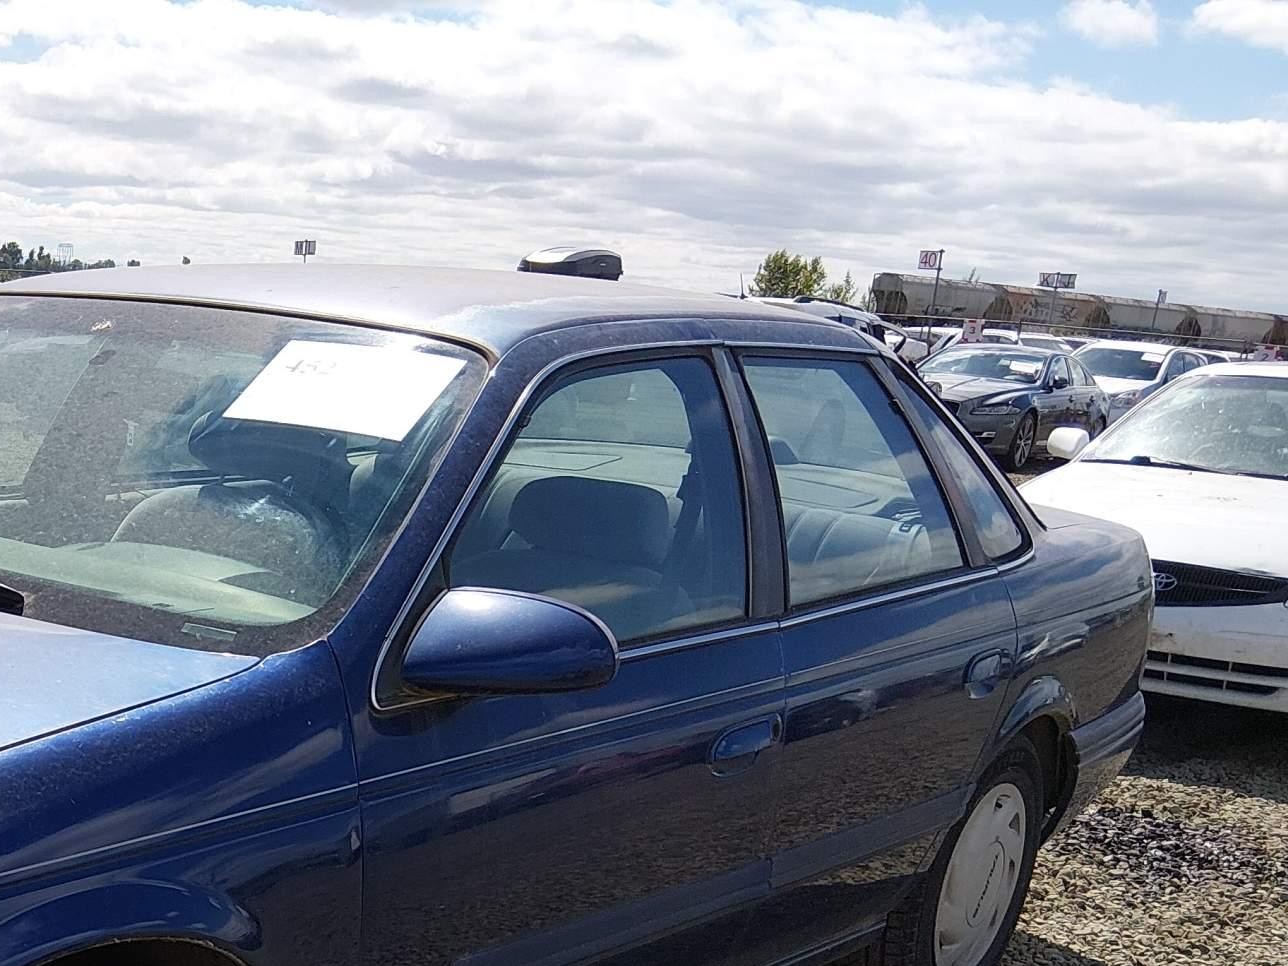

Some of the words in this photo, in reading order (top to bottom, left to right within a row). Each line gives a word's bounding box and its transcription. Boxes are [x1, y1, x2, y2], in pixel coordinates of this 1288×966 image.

[920, 252, 937, 267] 40
[1040, 273, 1052, 287] K
[970, 326, 976, 334] 3
